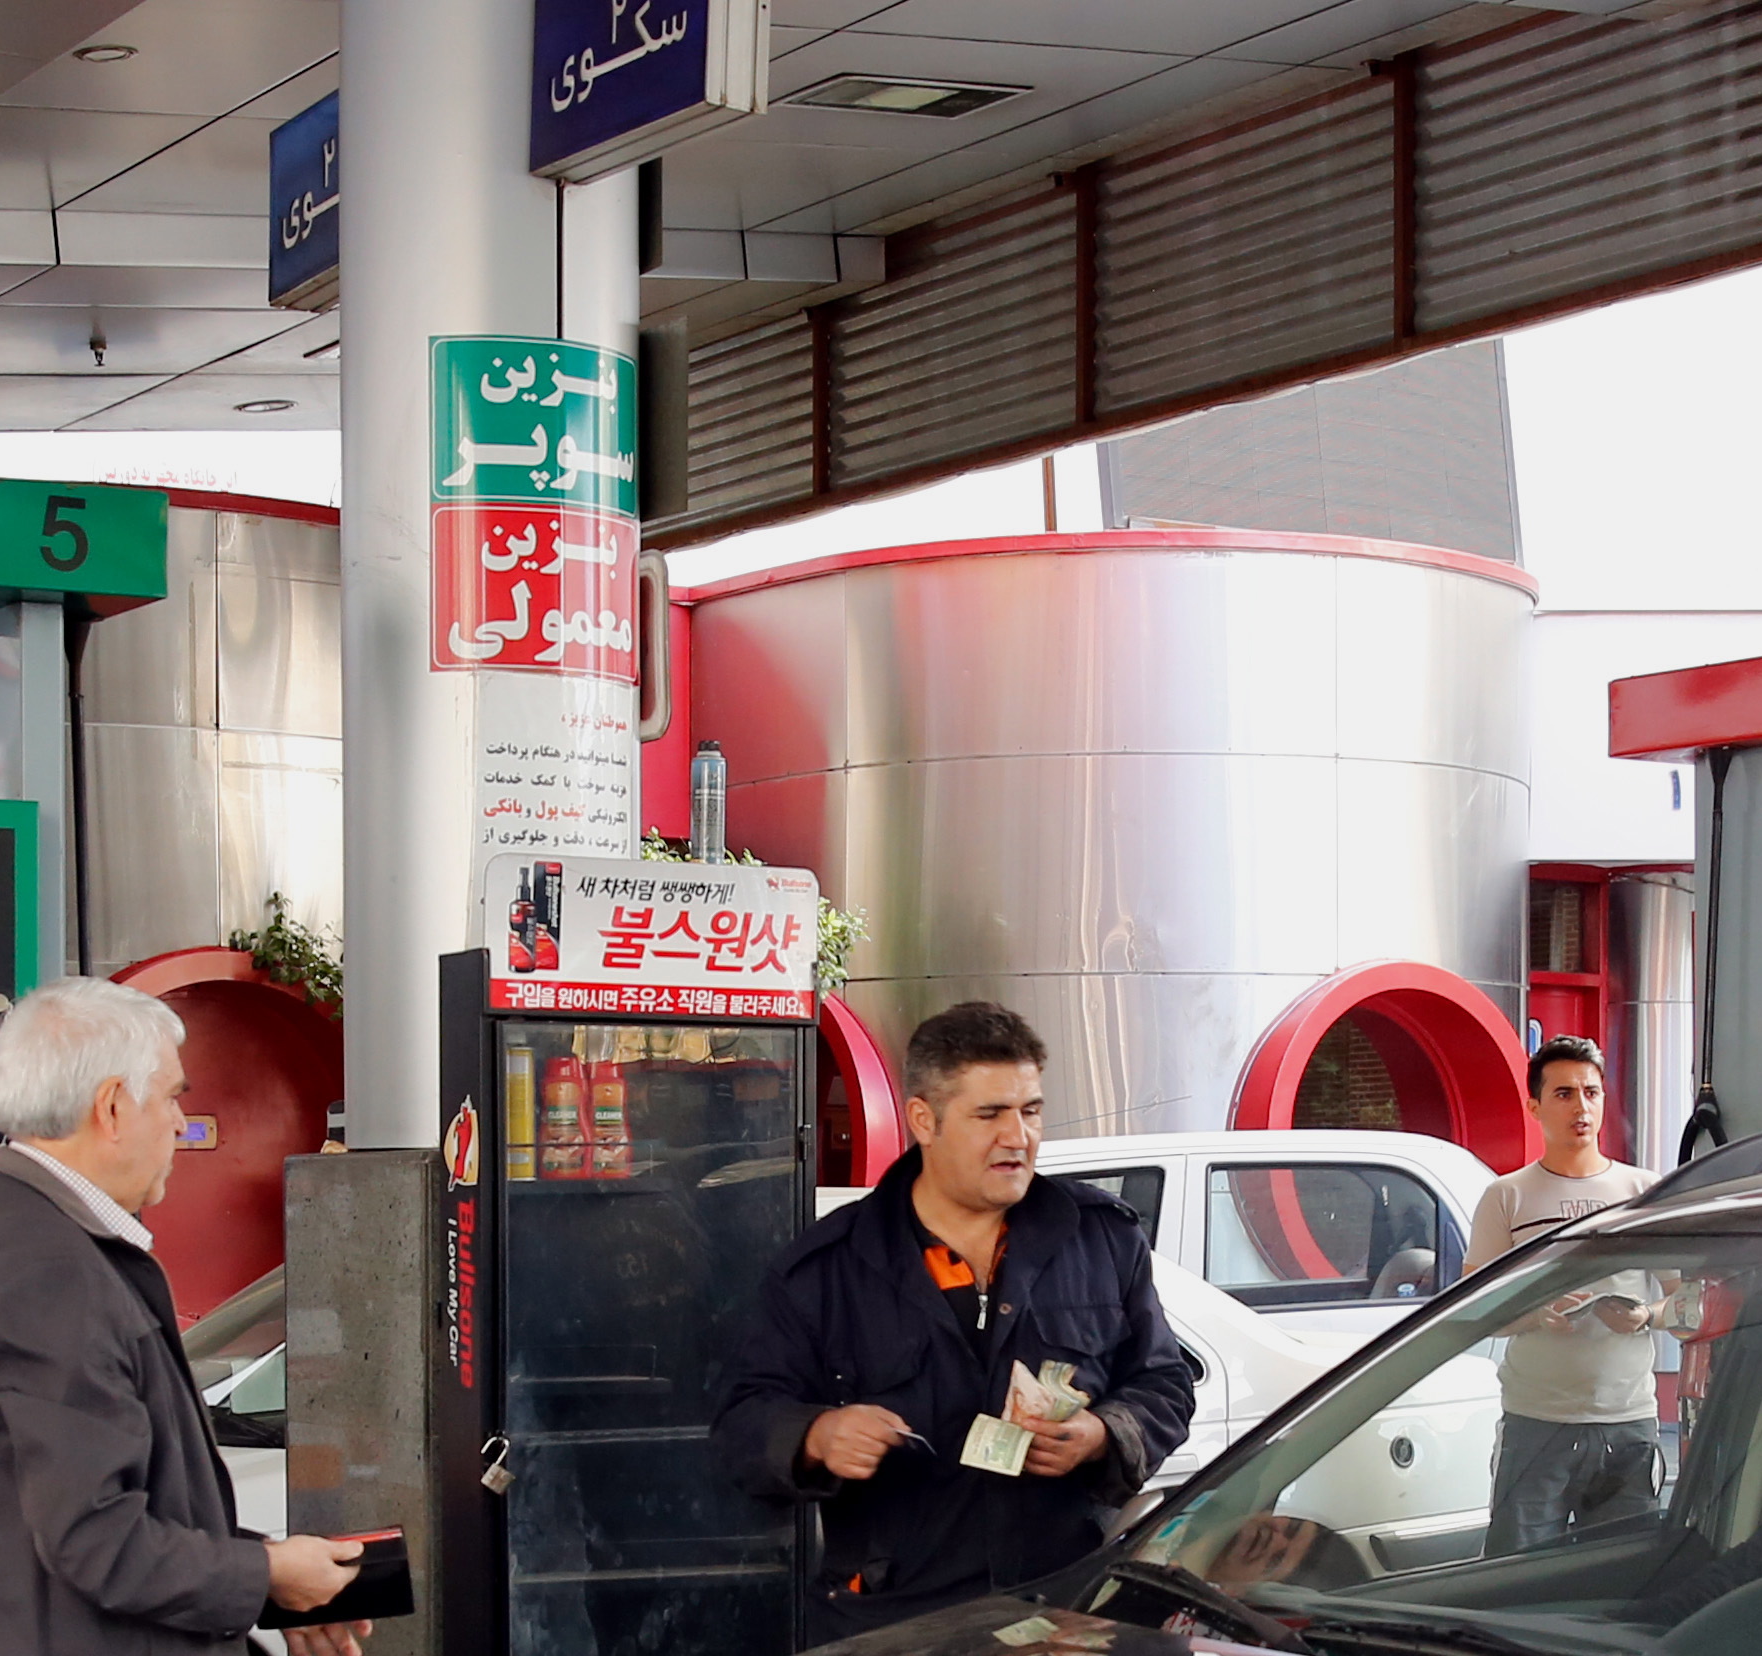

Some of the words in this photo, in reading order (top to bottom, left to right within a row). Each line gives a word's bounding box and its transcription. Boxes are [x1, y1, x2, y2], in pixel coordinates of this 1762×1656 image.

[549, 3, 688, 113] سکوی
[282, 190, 340, 250] وی
[479, 353, 619, 415] بنزین
[441, 423, 635, 491] سوپر
[39, 494, 89, 573] 5
[480, 520, 619, 581] بنزین
[447, 579, 634, 662] معمولی
[485, 742, 529, 761] پرداخت
[483, 770, 523, 785] خدمات
[530, 773, 557, 787] کمک
[482, 798, 523, 818] بانکی
[481, 827, 494, 844] از
[498, 828, 548, 847] جلوگیری
[575, 874, 595, 898] 새
[598, 877, 655, 902] 차처럼
[659, 880, 736, 906] 쌩쌩하게!
[597, 905, 802, 974] 불스원샷
[504, 982, 556, 1009] 구입을
[556, 986, 618, 1011] 원하시면
[619, 987, 675, 1013] 주유소
[677, 989, 728, 1015] 직원을
[447, 1229, 458, 1284] Love
[447, 1287, 459, 1322] My
[457, 1197, 477, 1391] Bullsone
[448, 1324, 460, 1368] Car
